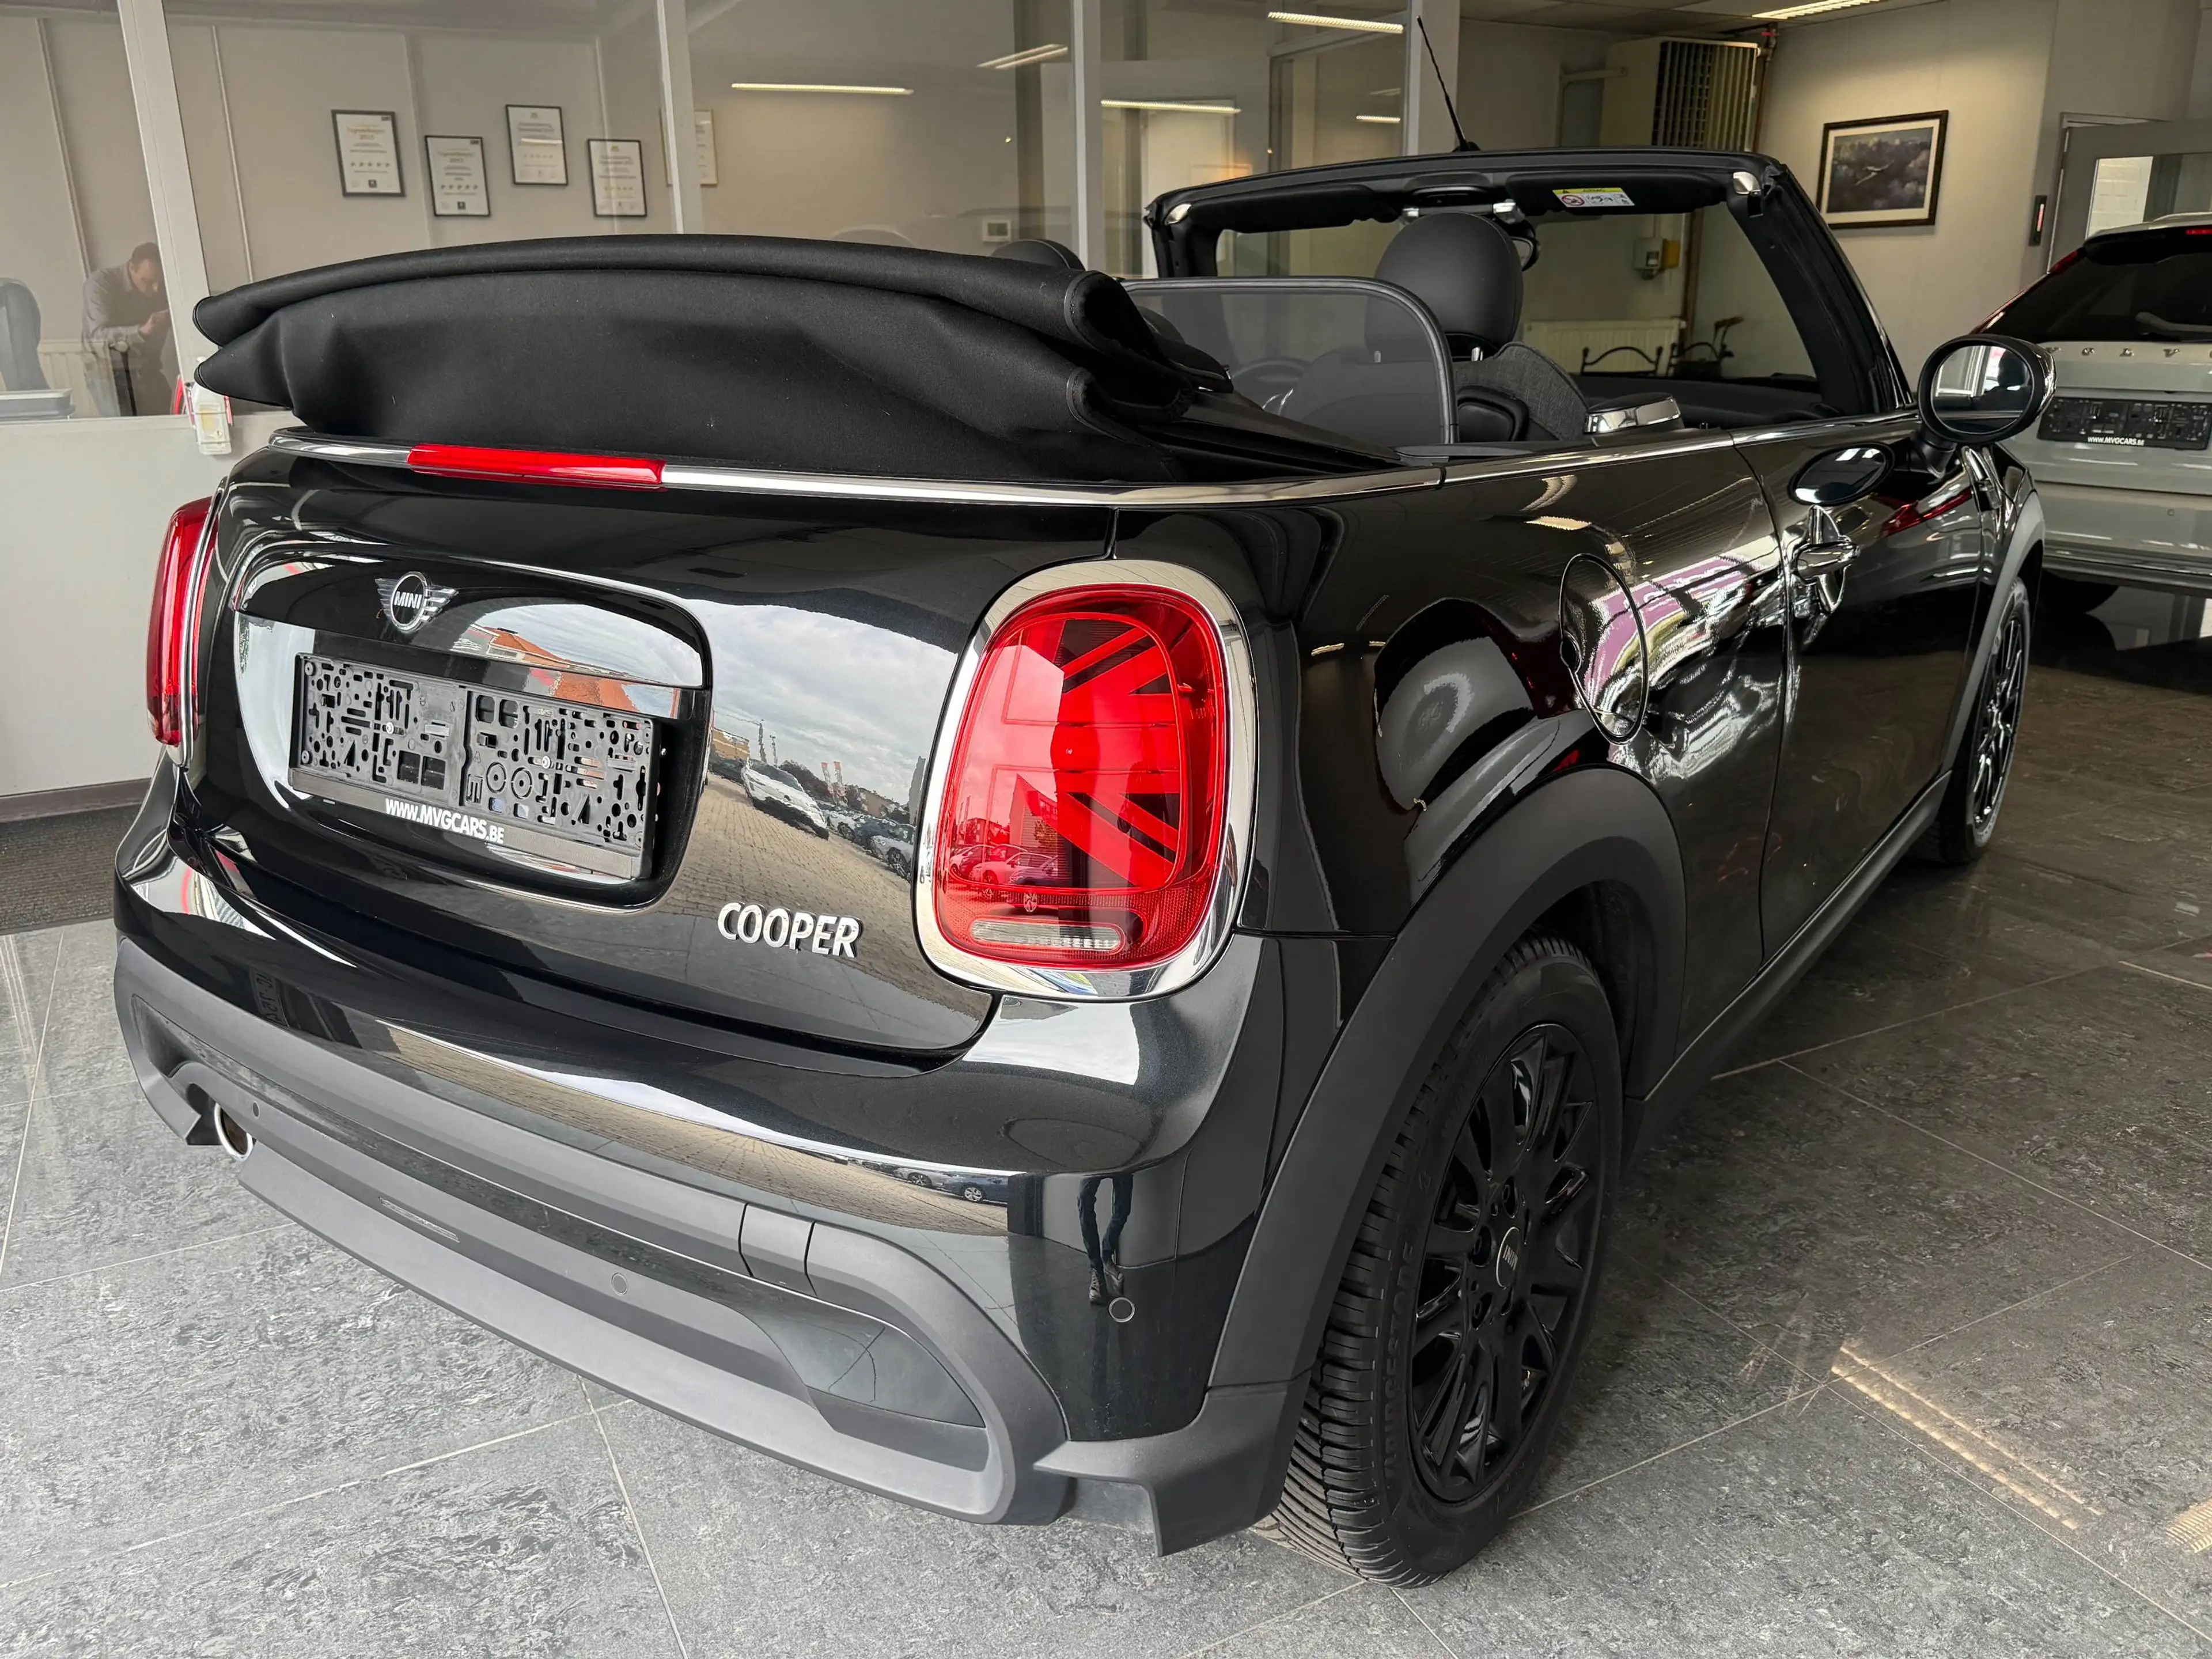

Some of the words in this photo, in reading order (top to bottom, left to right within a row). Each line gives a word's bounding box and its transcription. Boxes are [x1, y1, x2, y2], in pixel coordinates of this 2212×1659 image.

[2045, 347, 2212, 359] VOLV
[394, 591, 422, 609] MINI
[385, 798, 505, 844] WWW.MVGCARS.BE
[718, 902, 862, 959] COOPER
